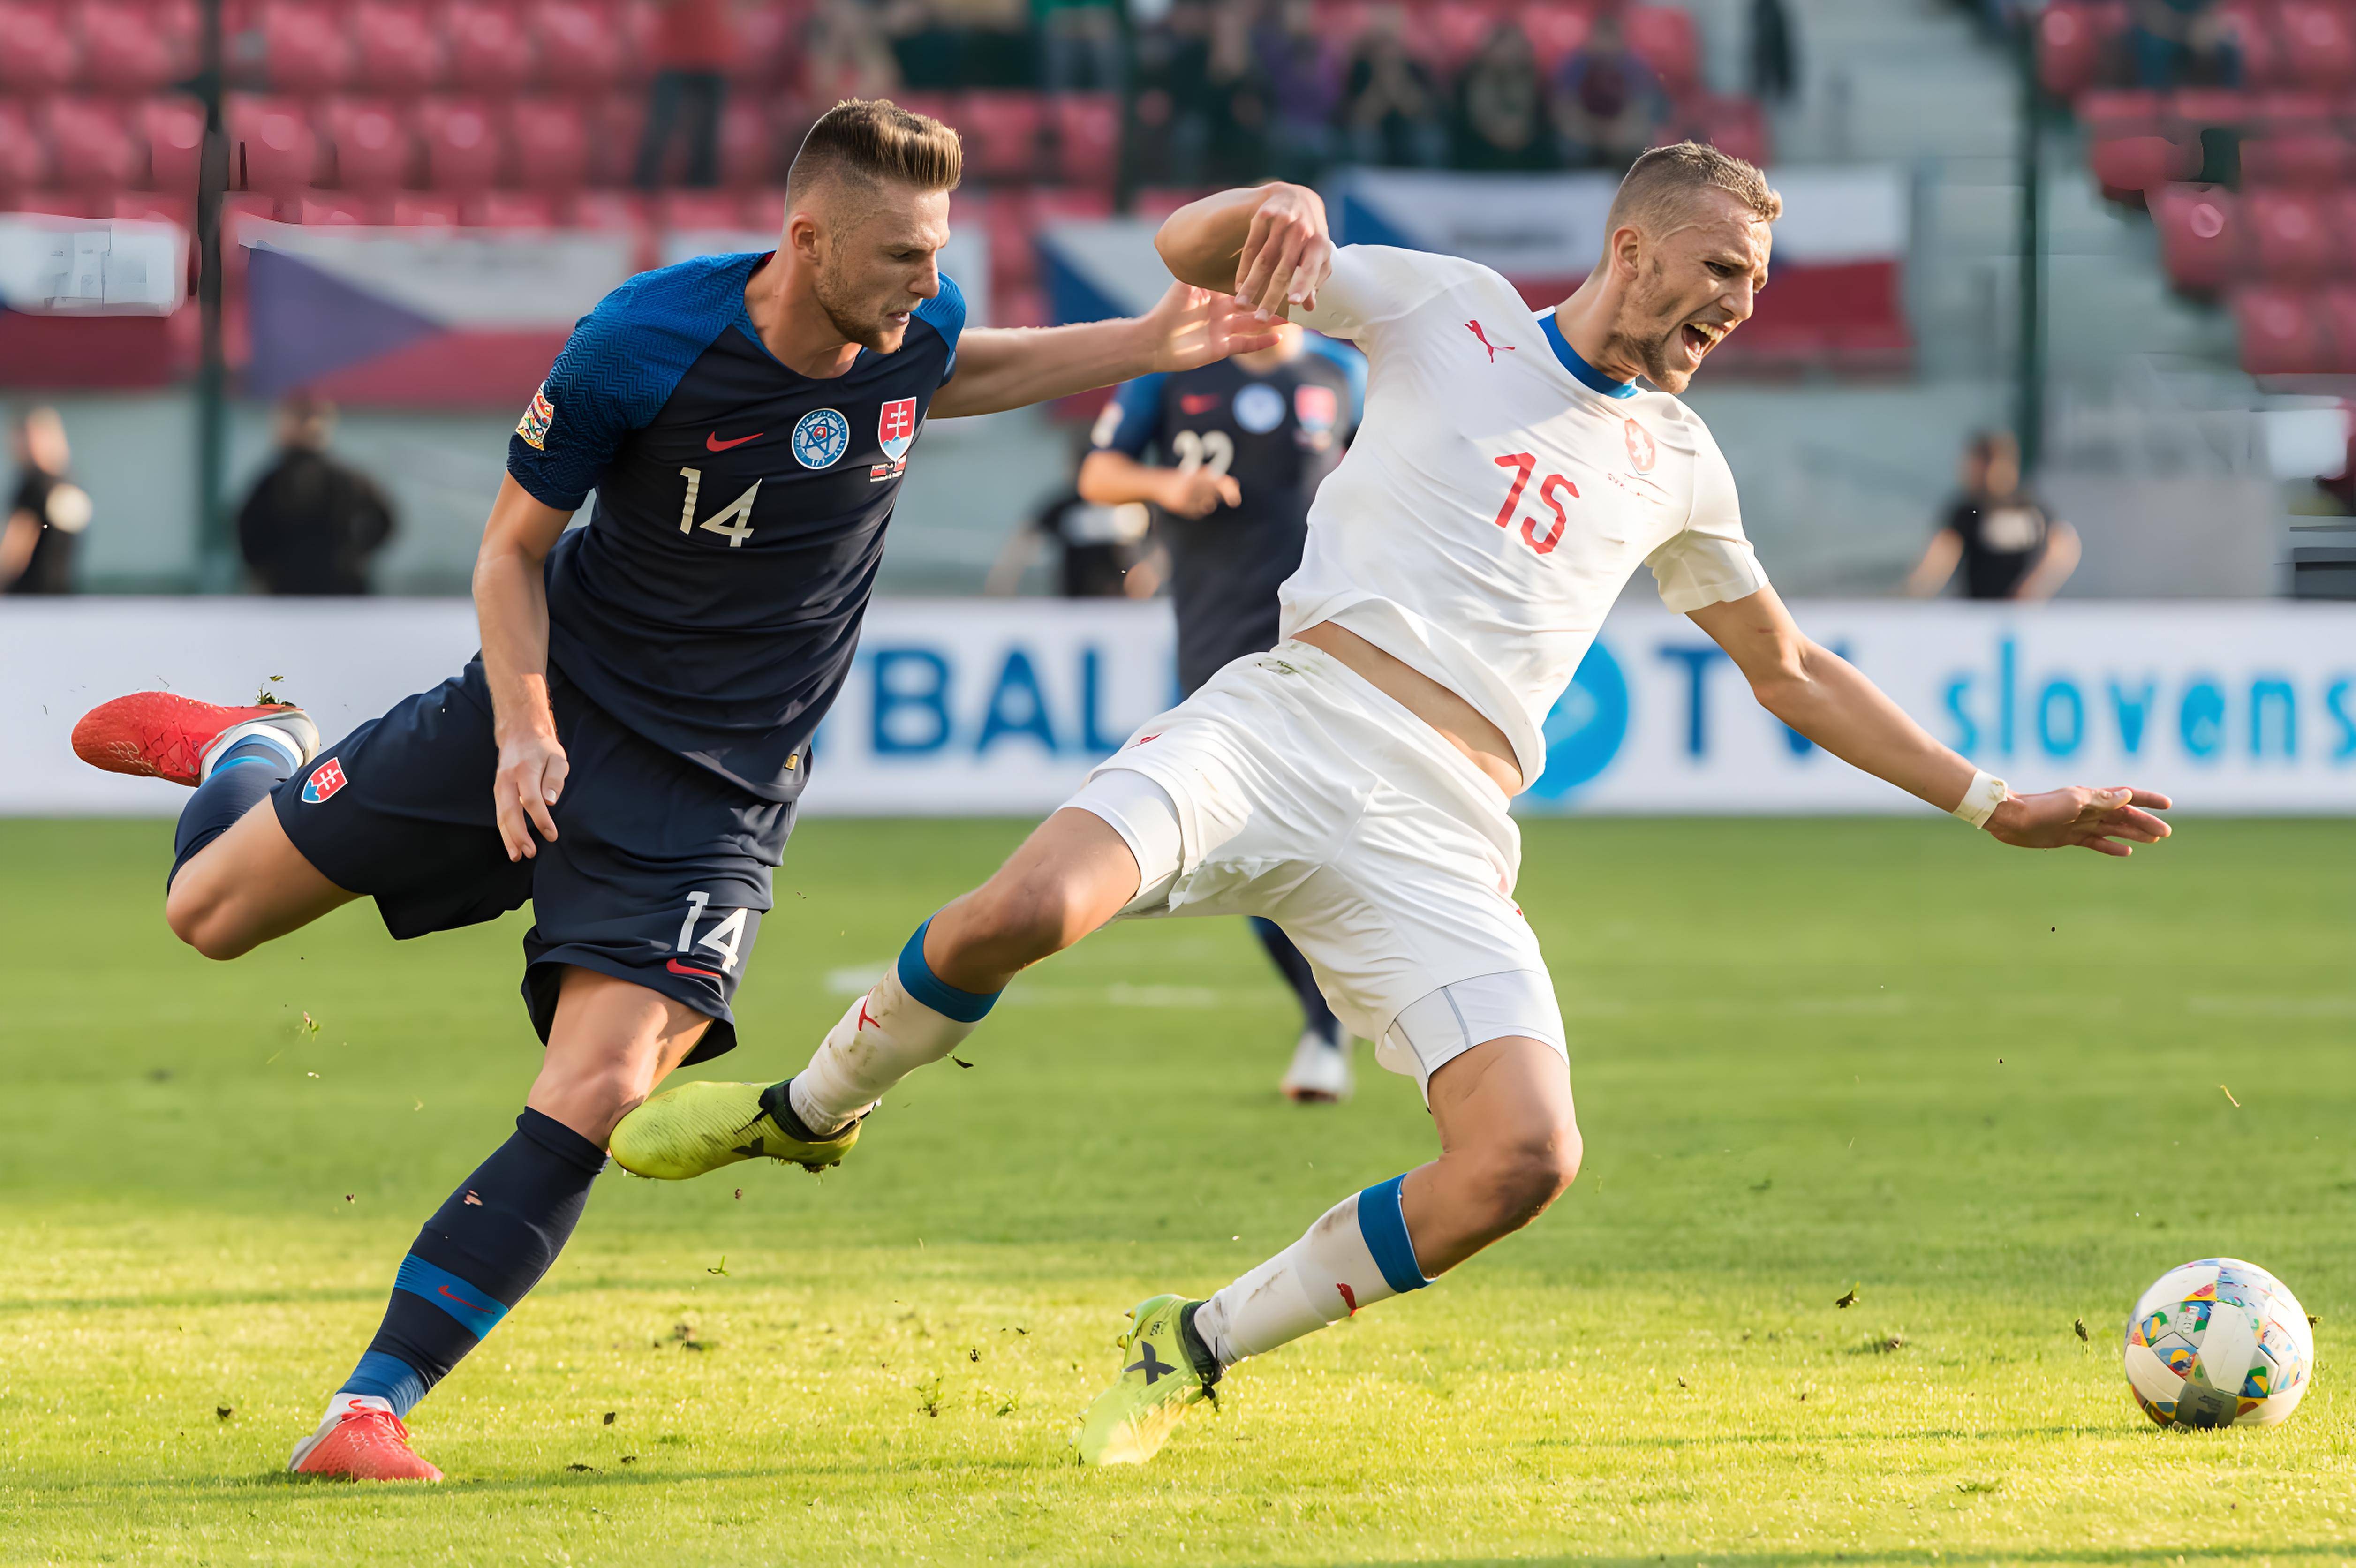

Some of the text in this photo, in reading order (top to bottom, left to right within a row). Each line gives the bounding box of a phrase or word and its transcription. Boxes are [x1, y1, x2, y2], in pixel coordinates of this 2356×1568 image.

[679, 467, 763, 547] 14
[1494, 452, 1580, 554] 15
[676, 890, 748, 975] 14
